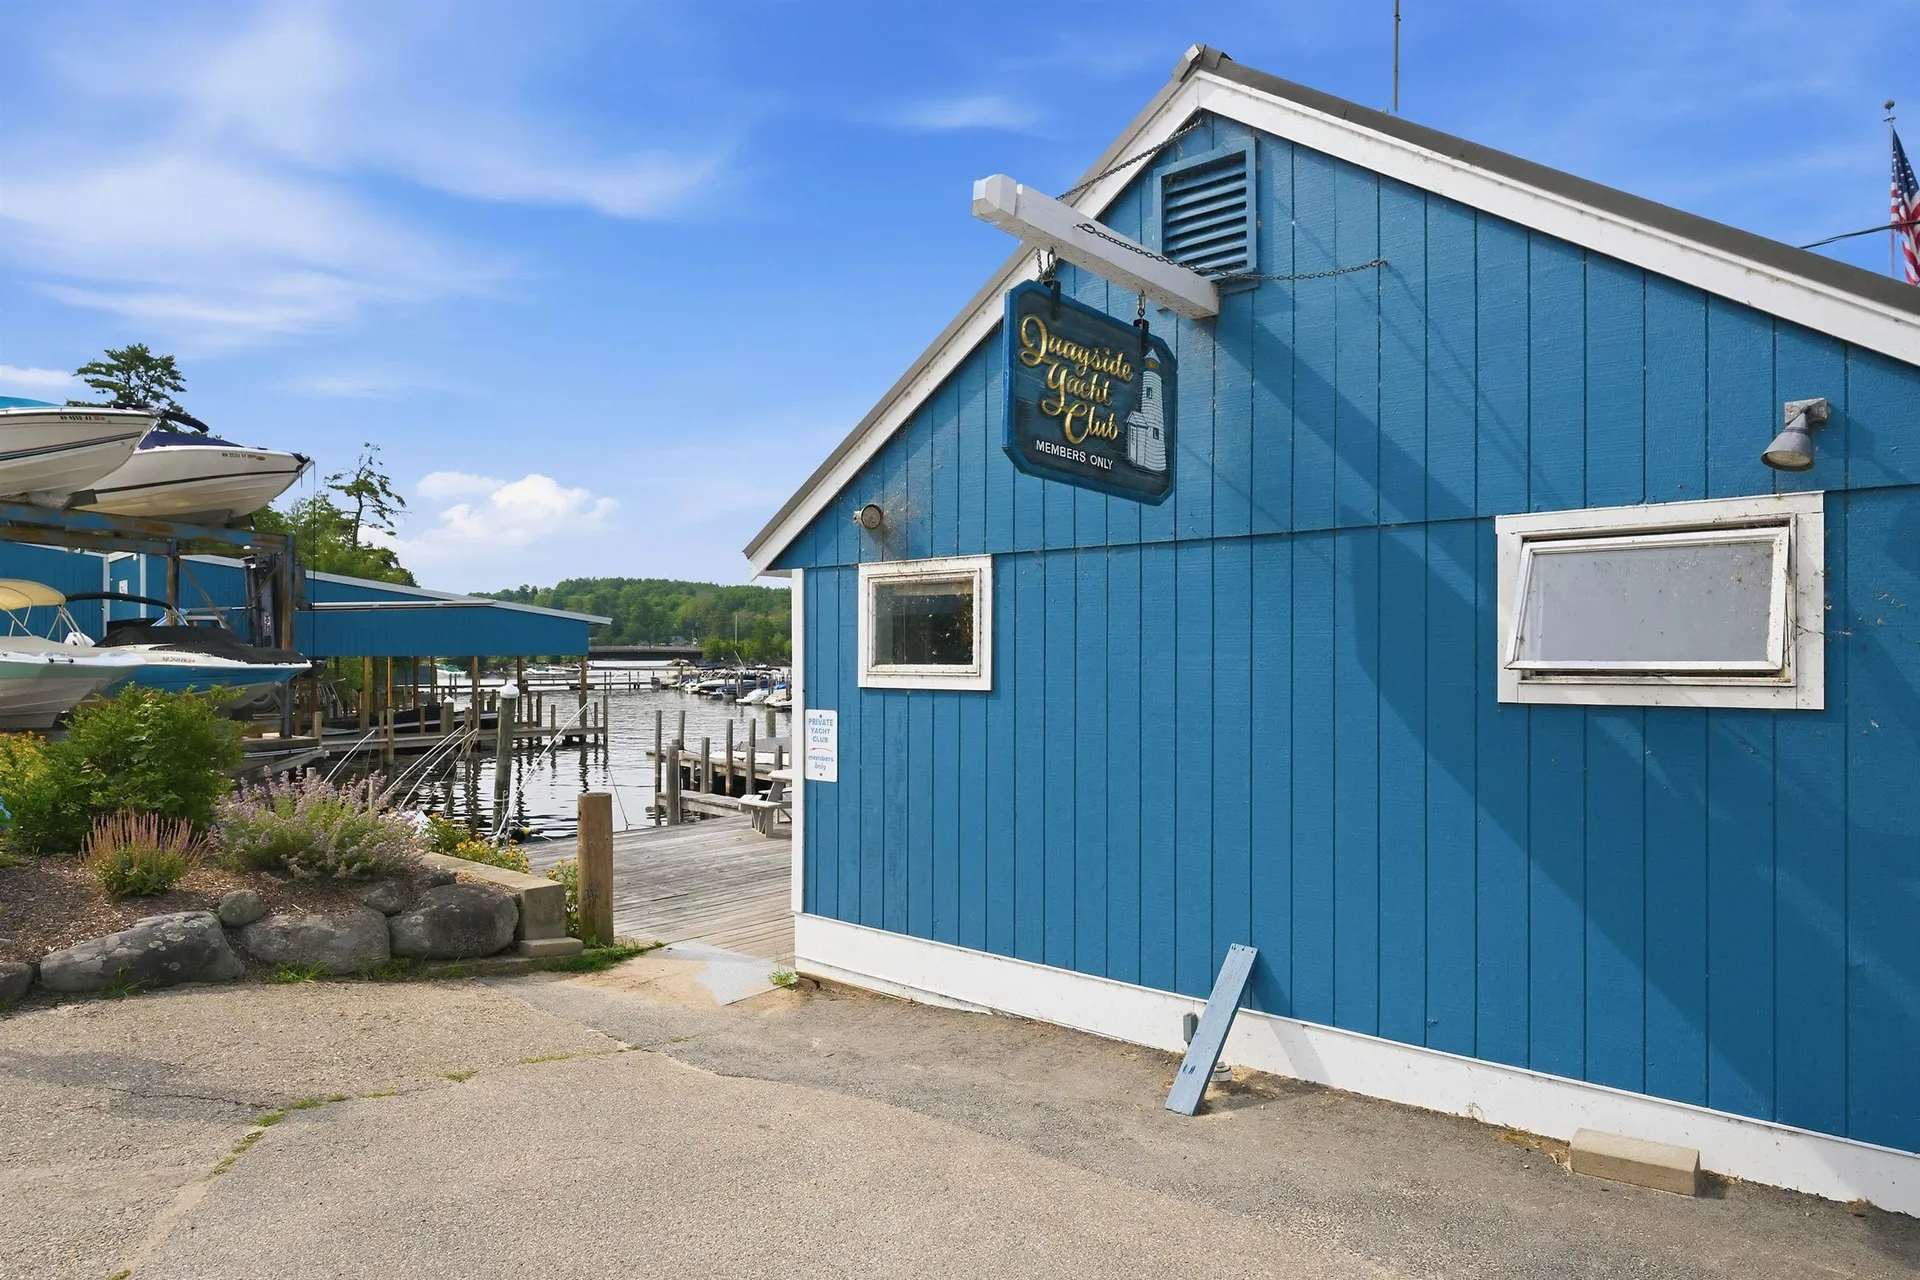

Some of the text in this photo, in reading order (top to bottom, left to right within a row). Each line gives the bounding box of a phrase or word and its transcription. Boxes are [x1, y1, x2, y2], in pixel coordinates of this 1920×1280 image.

[1020, 314, 1133, 381] Quayside
[1042, 362, 1113, 416] Yacht
[1064, 403, 1118, 444] Club
[1036, 440, 1113, 470] MEMBERS ONLY
[808, 718, 834, 727] PRIVATE
[810, 727, 831, 735] YACHT
[812, 735, 829, 743] CLUB
